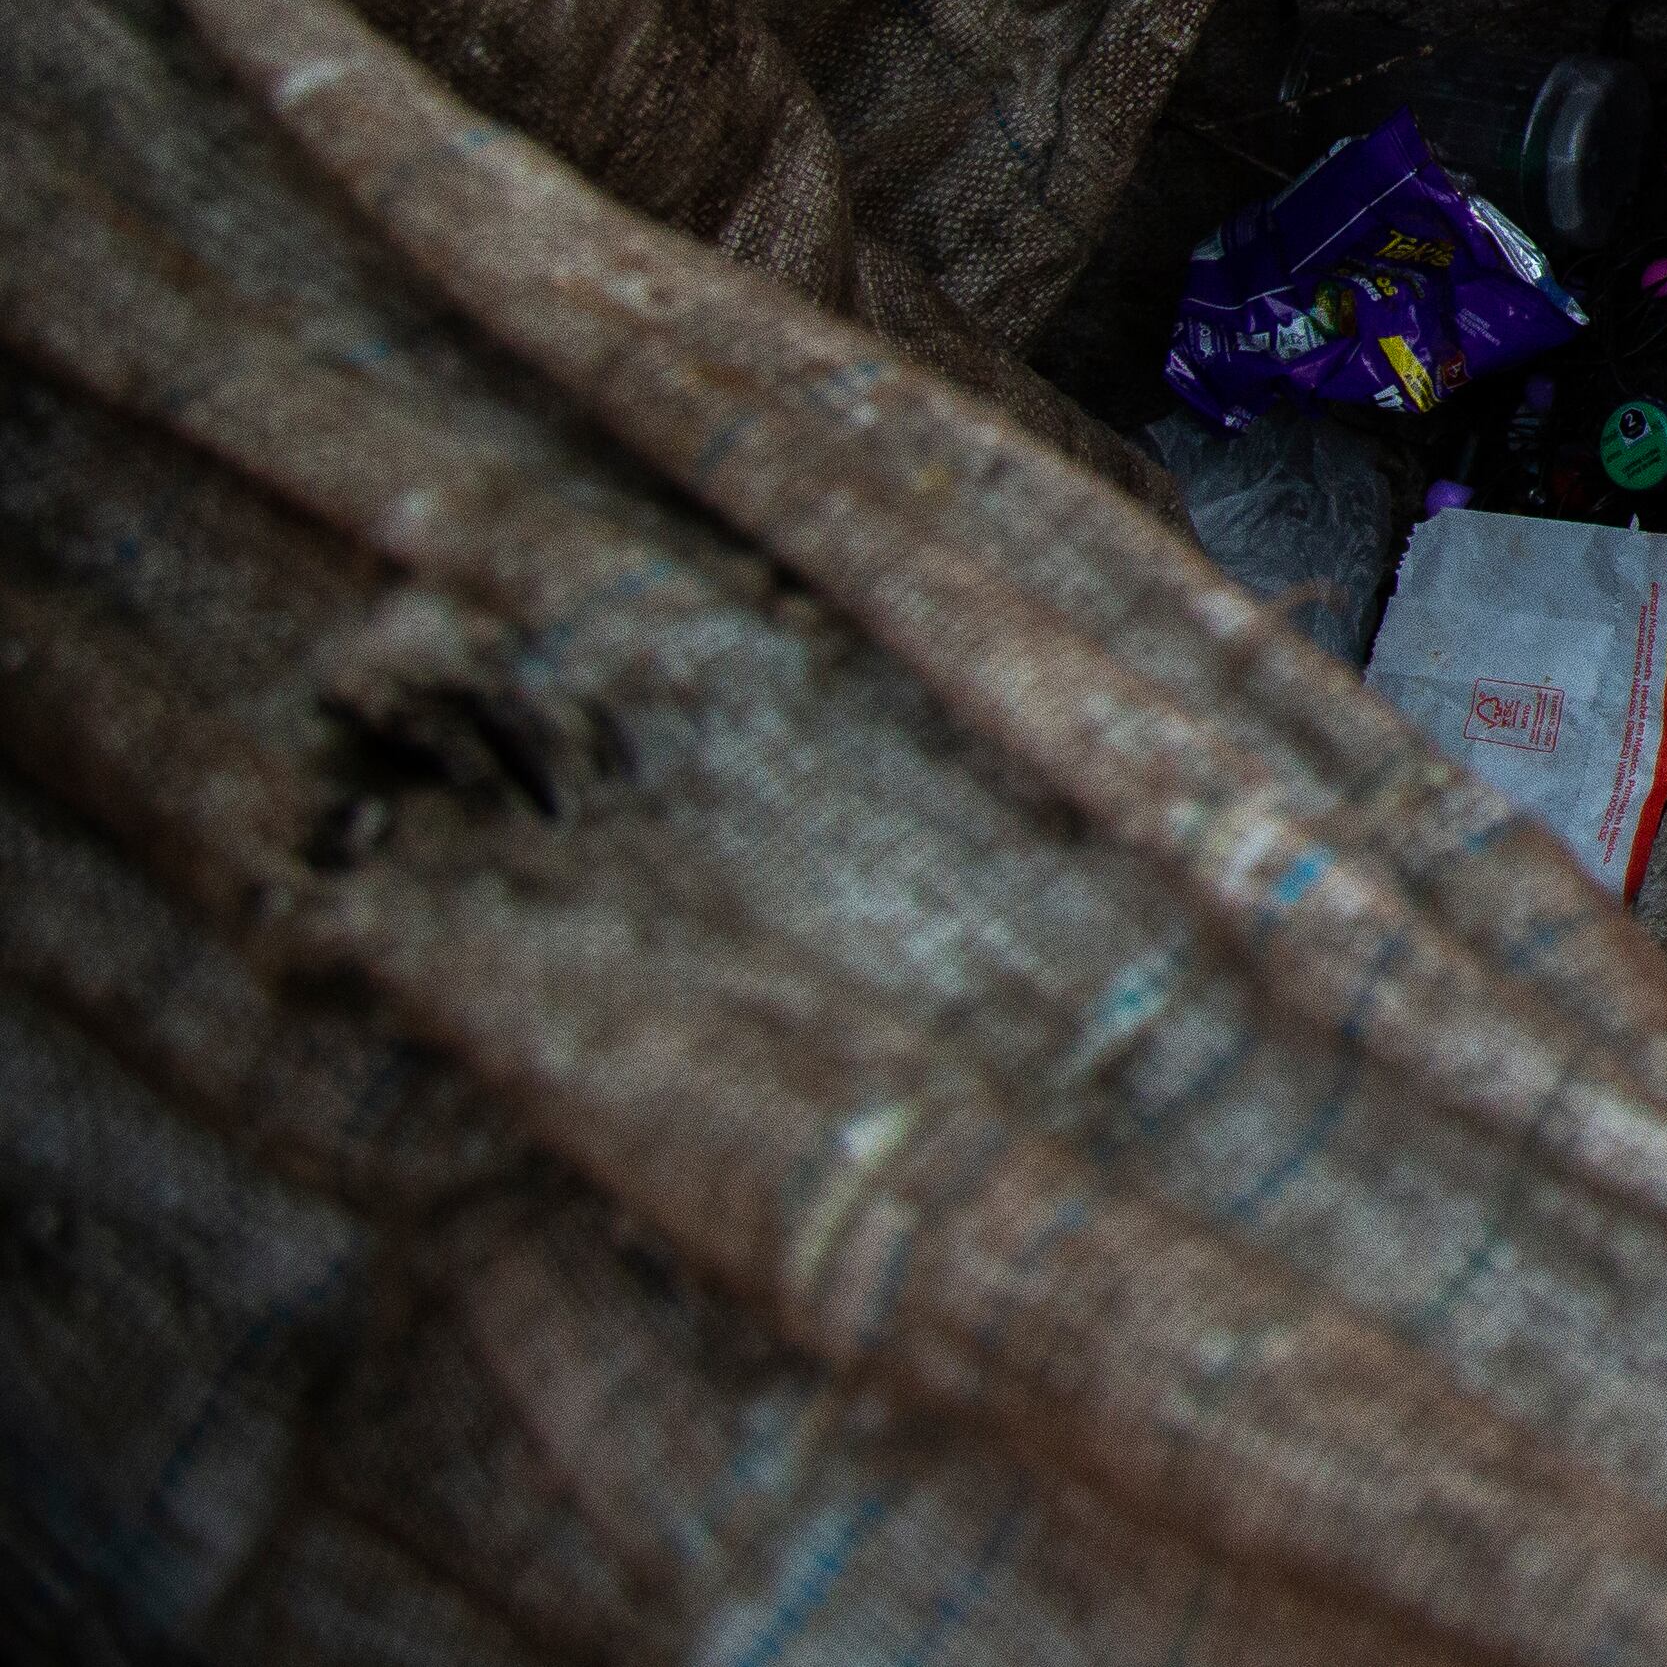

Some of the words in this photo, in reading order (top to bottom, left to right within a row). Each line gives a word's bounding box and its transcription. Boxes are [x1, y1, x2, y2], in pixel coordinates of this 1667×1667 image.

[1373, 227, 1455, 268] Takis
[1623, 411, 1637, 427] 2
[1640, 685, 1651, 719] Hecho
[1636, 722, 1645, 736] en
[1617, 779, 1635, 813] Printed
[1614, 814, 1624, 825] in
